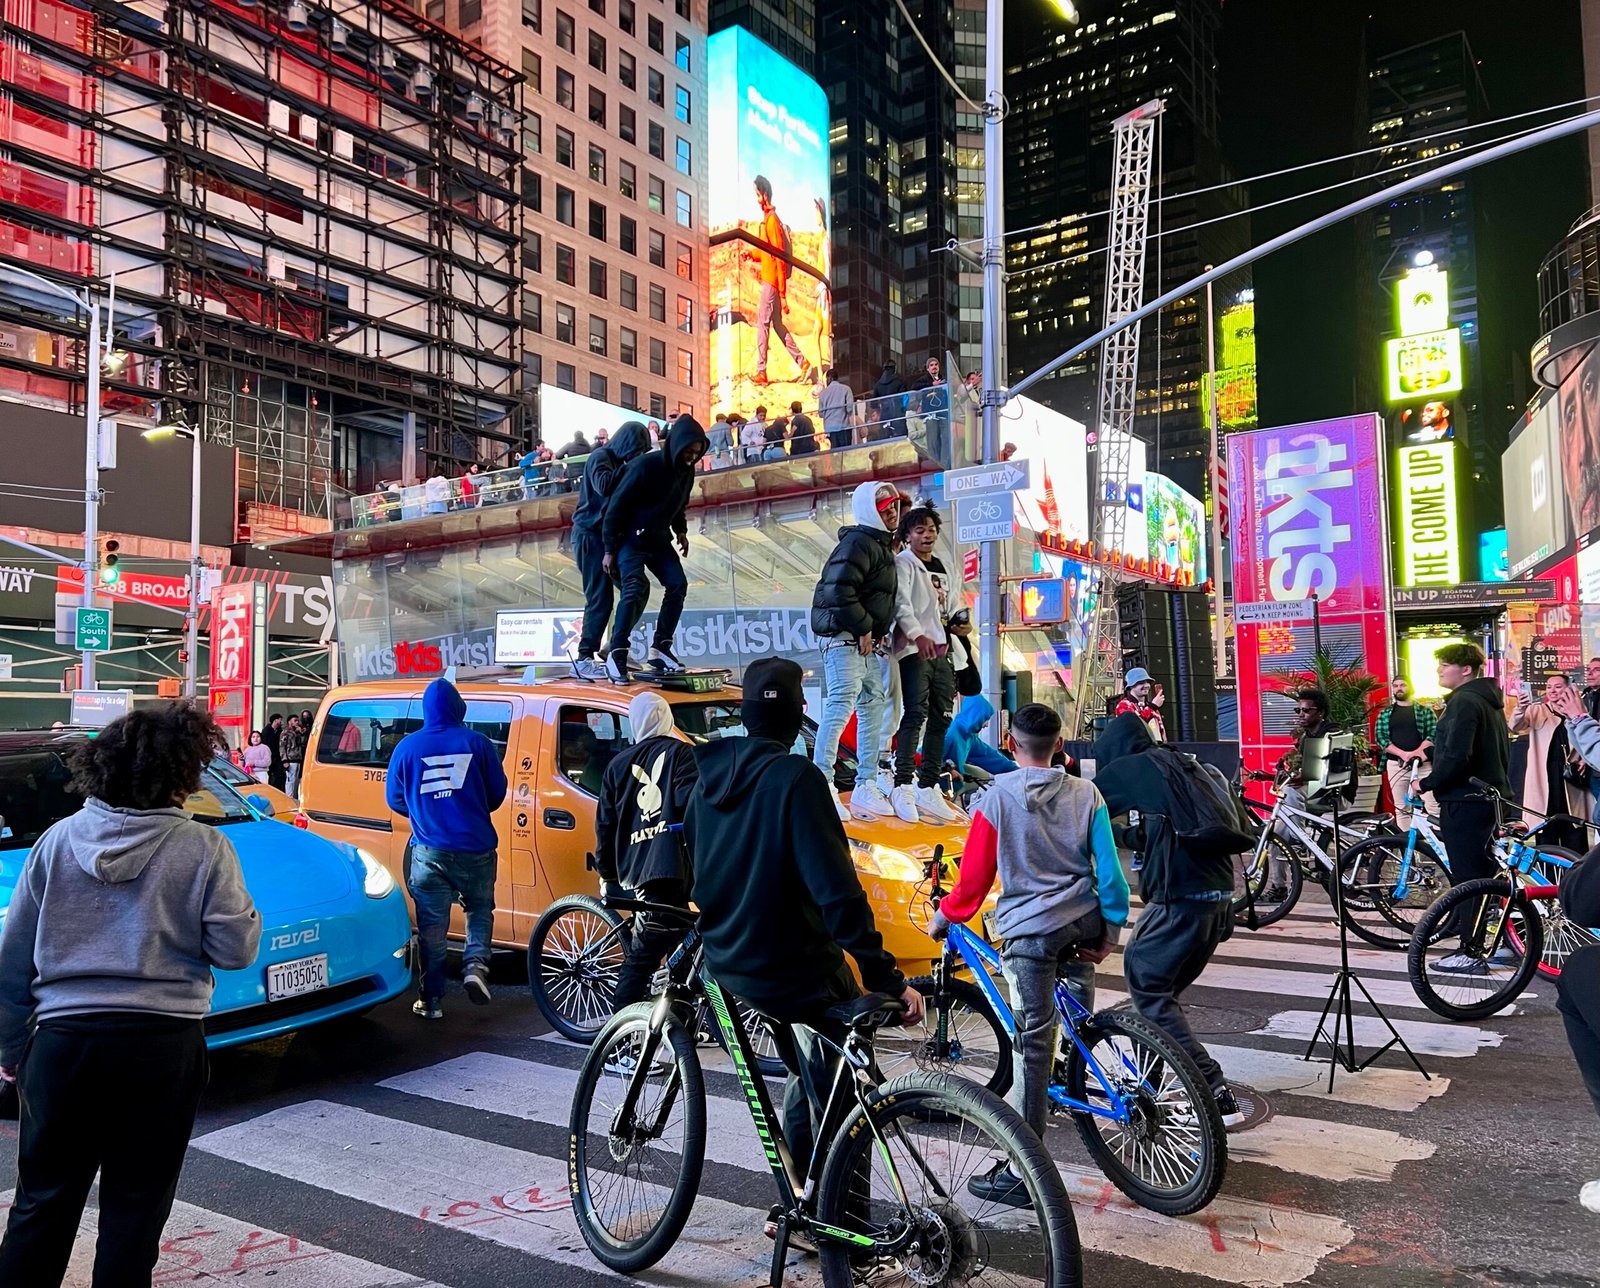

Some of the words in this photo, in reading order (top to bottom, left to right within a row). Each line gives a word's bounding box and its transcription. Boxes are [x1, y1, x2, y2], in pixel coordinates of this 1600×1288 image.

[1409, 450, 1444, 477] UP
[957, 476, 979, 489] ONE
[991, 471, 1016, 484] WAY
[1255, 504, 1264, 534] Theatre
[1265, 437, 1353, 602] tkts
[1410, 482, 1448, 544] COME
[962, 527, 981, 539] BIKE
[985, 524, 1010, 536] LANE
[1256, 535, 1265, 587] Development
[1414, 553, 1449, 586] THE
[132, 582, 190, 600] BROAD
[1259, 588, 1267, 603] Fun
[1418, 590, 1438, 601] UP
[1239, 604, 1271, 613] PEDESTRIAN
[80, 627, 107, 636] South
[220, 592, 246, 680] tkts
[501, 618, 513, 627] Easy
[1534, 655, 1581, 663] CURTAIN
[270, 924, 320, 951] revel
[274, 964, 323, 992] T103505C
[284, 962, 299, 971] NEW
[299, 959, 314, 968] YORK
[849, 1095, 897, 1139] MAXIS
[571, 1134, 579, 1193] MAXXIS
